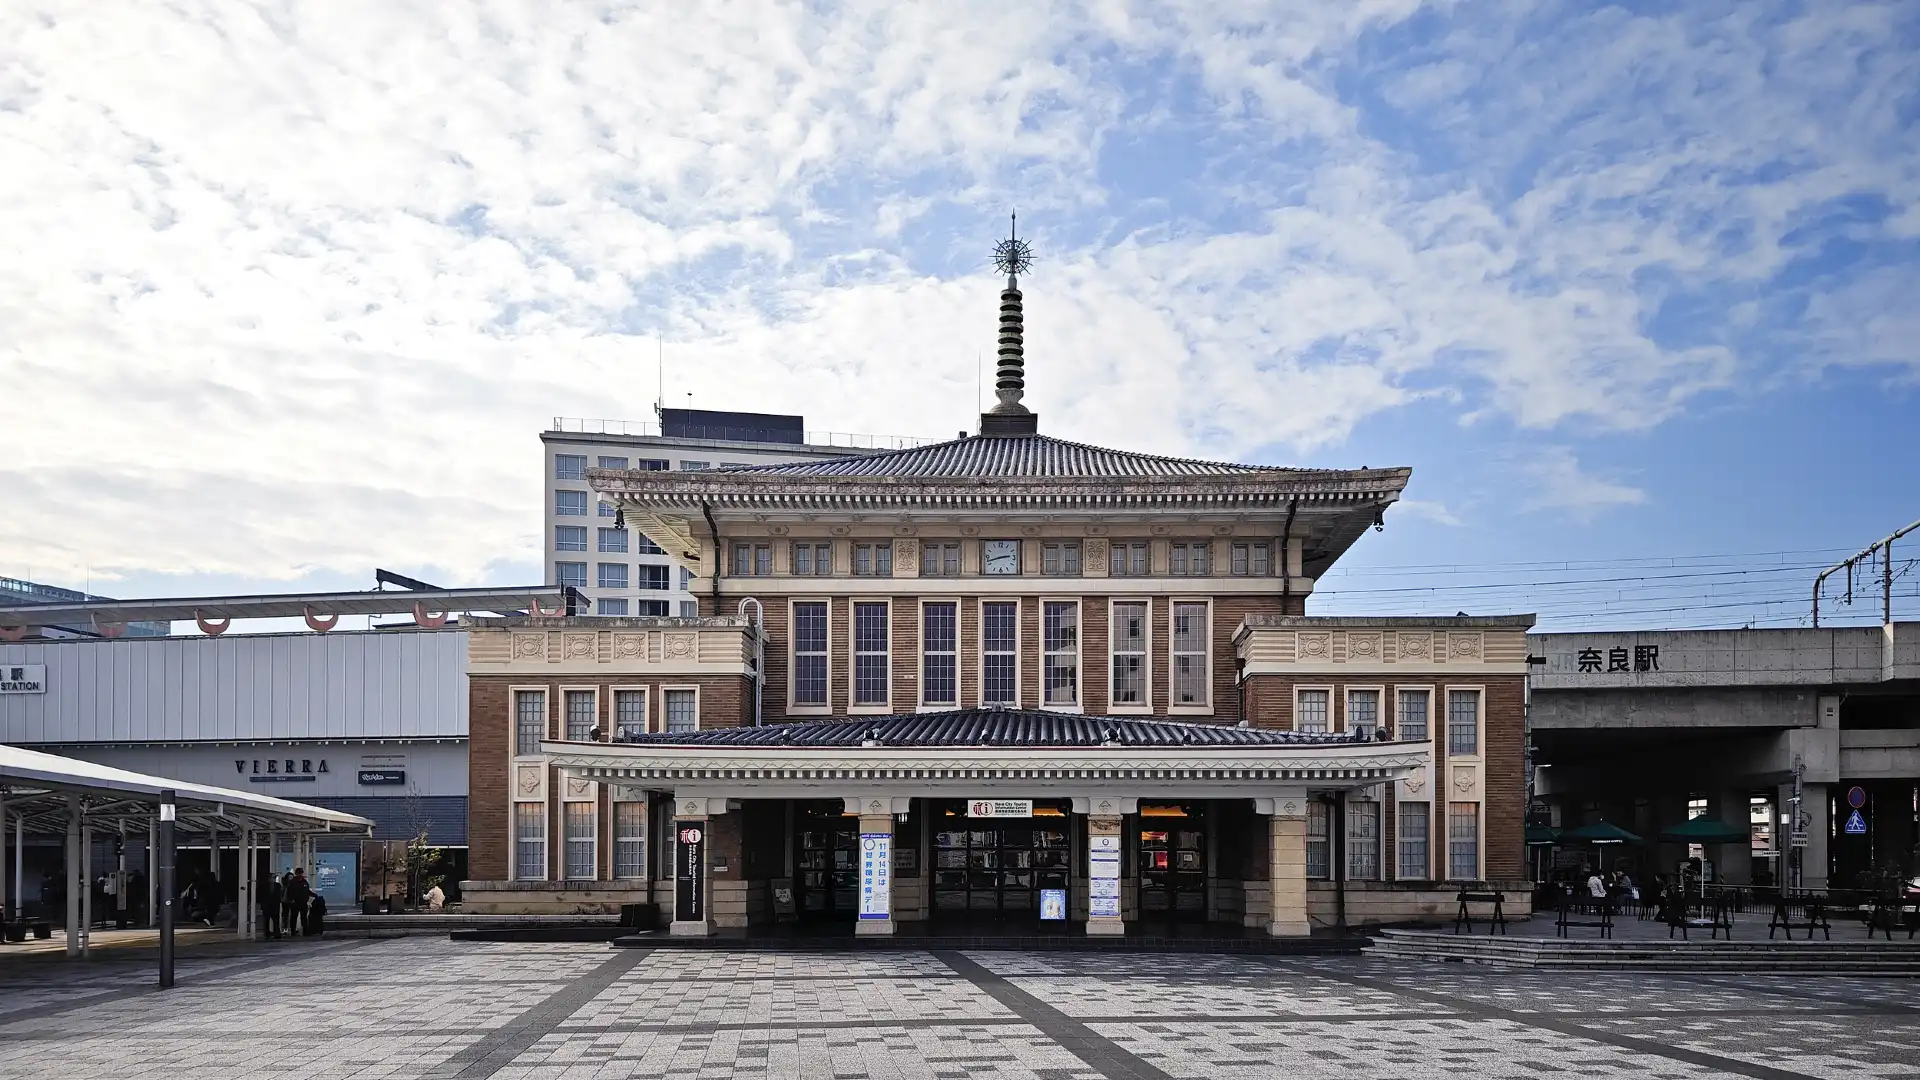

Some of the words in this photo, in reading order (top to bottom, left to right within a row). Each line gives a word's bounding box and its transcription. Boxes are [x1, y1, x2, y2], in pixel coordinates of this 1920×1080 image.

[0, 681, 39, 691] STATION
[235, 759, 328, 774] VIERRA
[878, 843, 887, 886] 11月14日は
